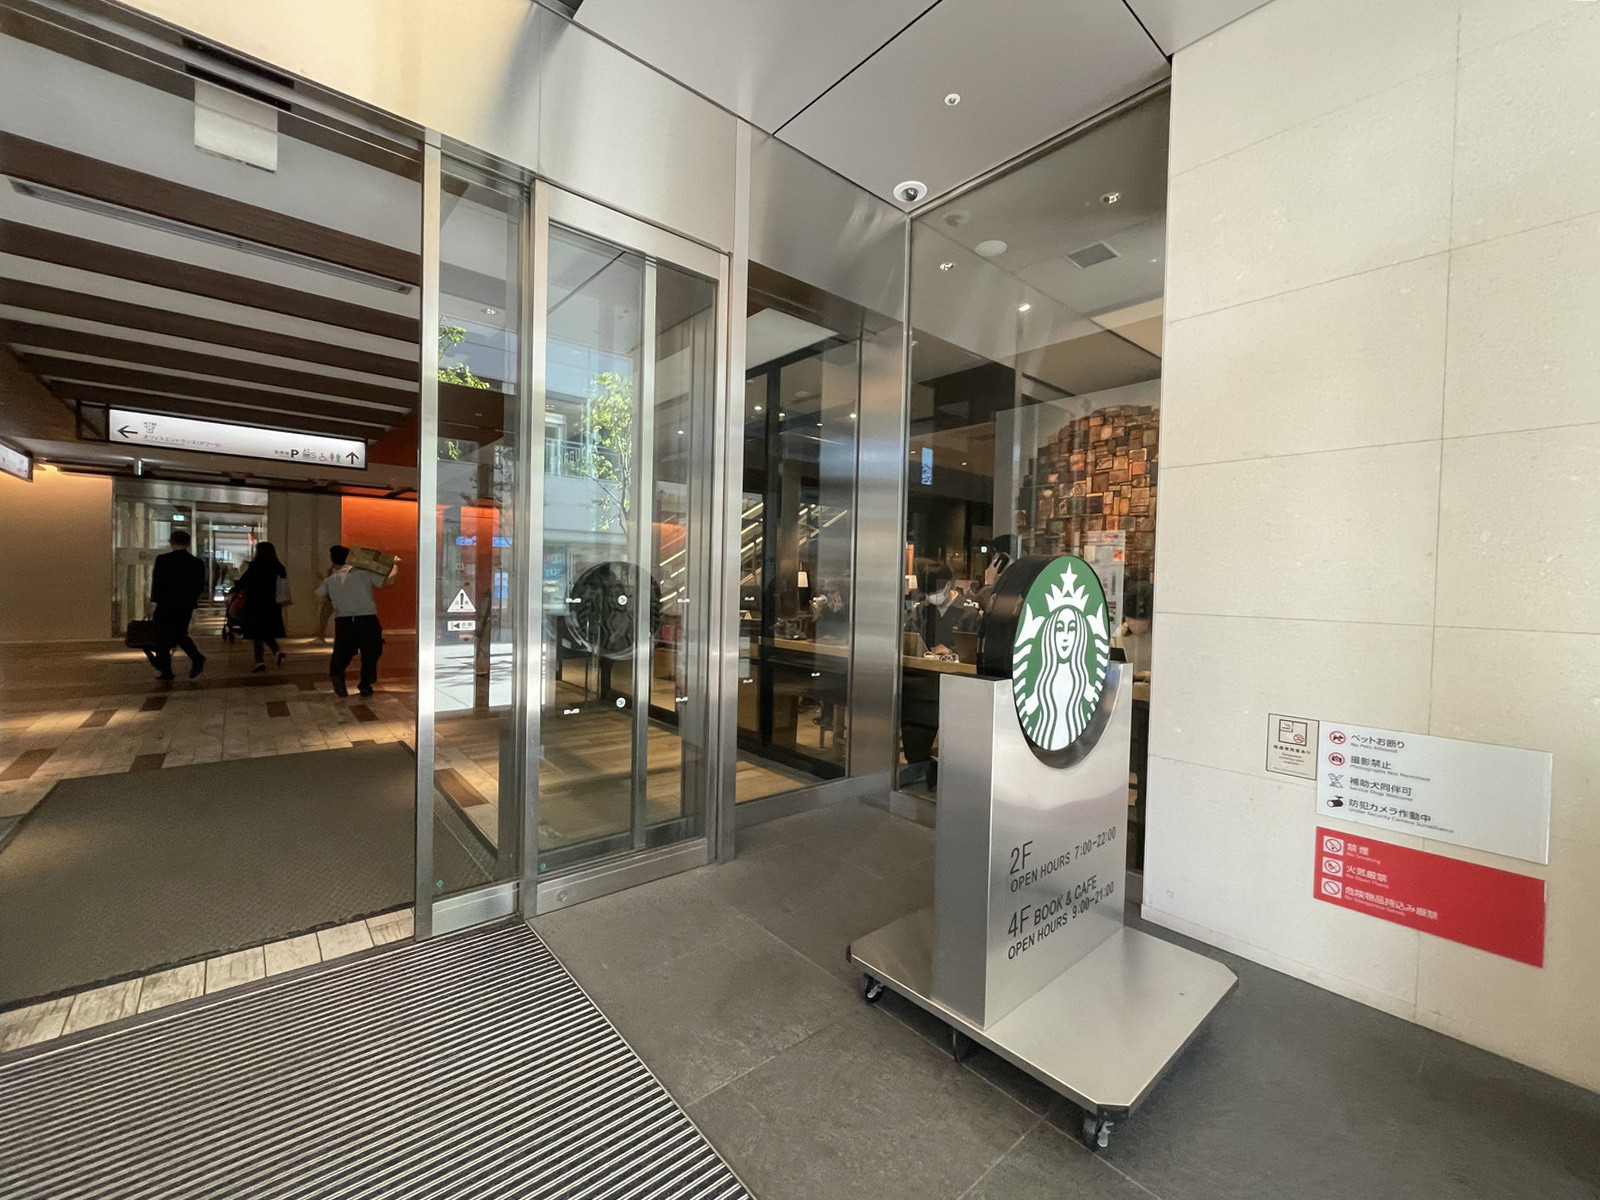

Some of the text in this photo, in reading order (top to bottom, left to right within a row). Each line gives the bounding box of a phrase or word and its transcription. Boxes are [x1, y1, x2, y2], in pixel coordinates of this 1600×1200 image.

[290, 448, 300, 459] P
[1350, 733, 1405, 750] ペットお断り
[1350, 755, 1392, 770] 撮影禁止
[1349, 776, 1413, 797] 補助犬同伴可
[1348, 798, 1432, 823] 防犯カメラ作動中
[1366, 811, 1391, 821] Security
[1010, 840, 1033, 875] 2F
[1010, 868, 1038, 893] OPEN
[1040, 852, 1071, 878] HOURS
[1346, 865, 1388, 883] 火気厳禁
[1008, 874, 1097, 938] 4F BOOK & CAFE
[1344, 886, 1438, 920] 危険物品持込み厳禁
[1008, 932, 1035, 960] OPEN
[1037, 912, 1068, 942] HOURS
